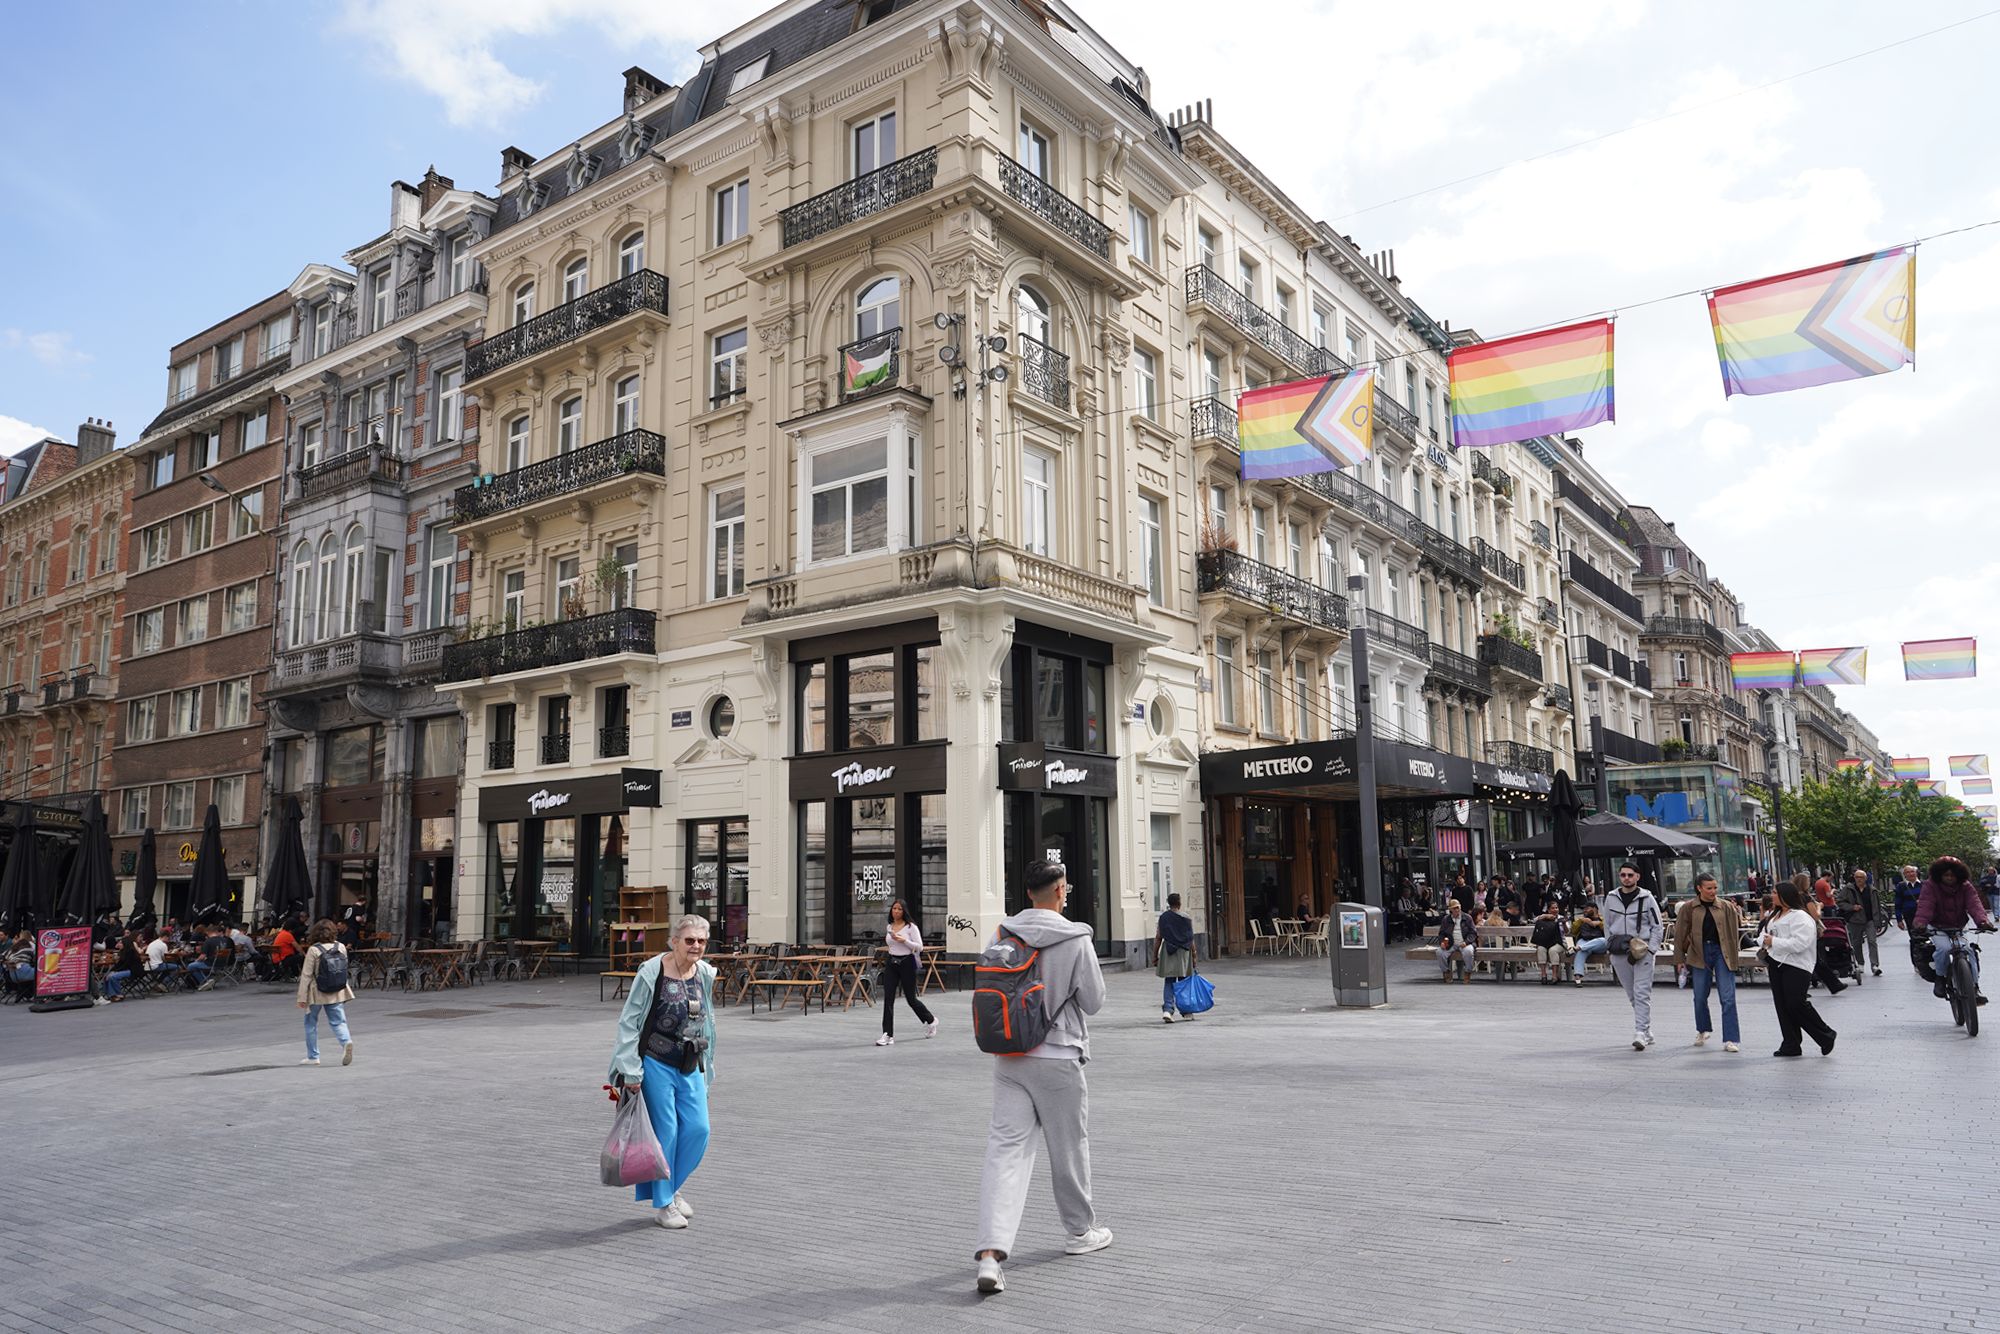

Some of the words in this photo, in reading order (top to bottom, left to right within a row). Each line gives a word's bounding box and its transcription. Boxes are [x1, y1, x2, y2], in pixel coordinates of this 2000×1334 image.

[1243, 756, 1313, 778] METTEKO
[1409, 759, 1435, 778] METTEKO
[35, 810, 80, 822] LSTAFF
[1046, 848, 1062, 864] FIRE
[863, 864, 883, 880] BEST
[854, 879, 892, 895] FALAFELS
[546, 894, 569, 903] BREAD
